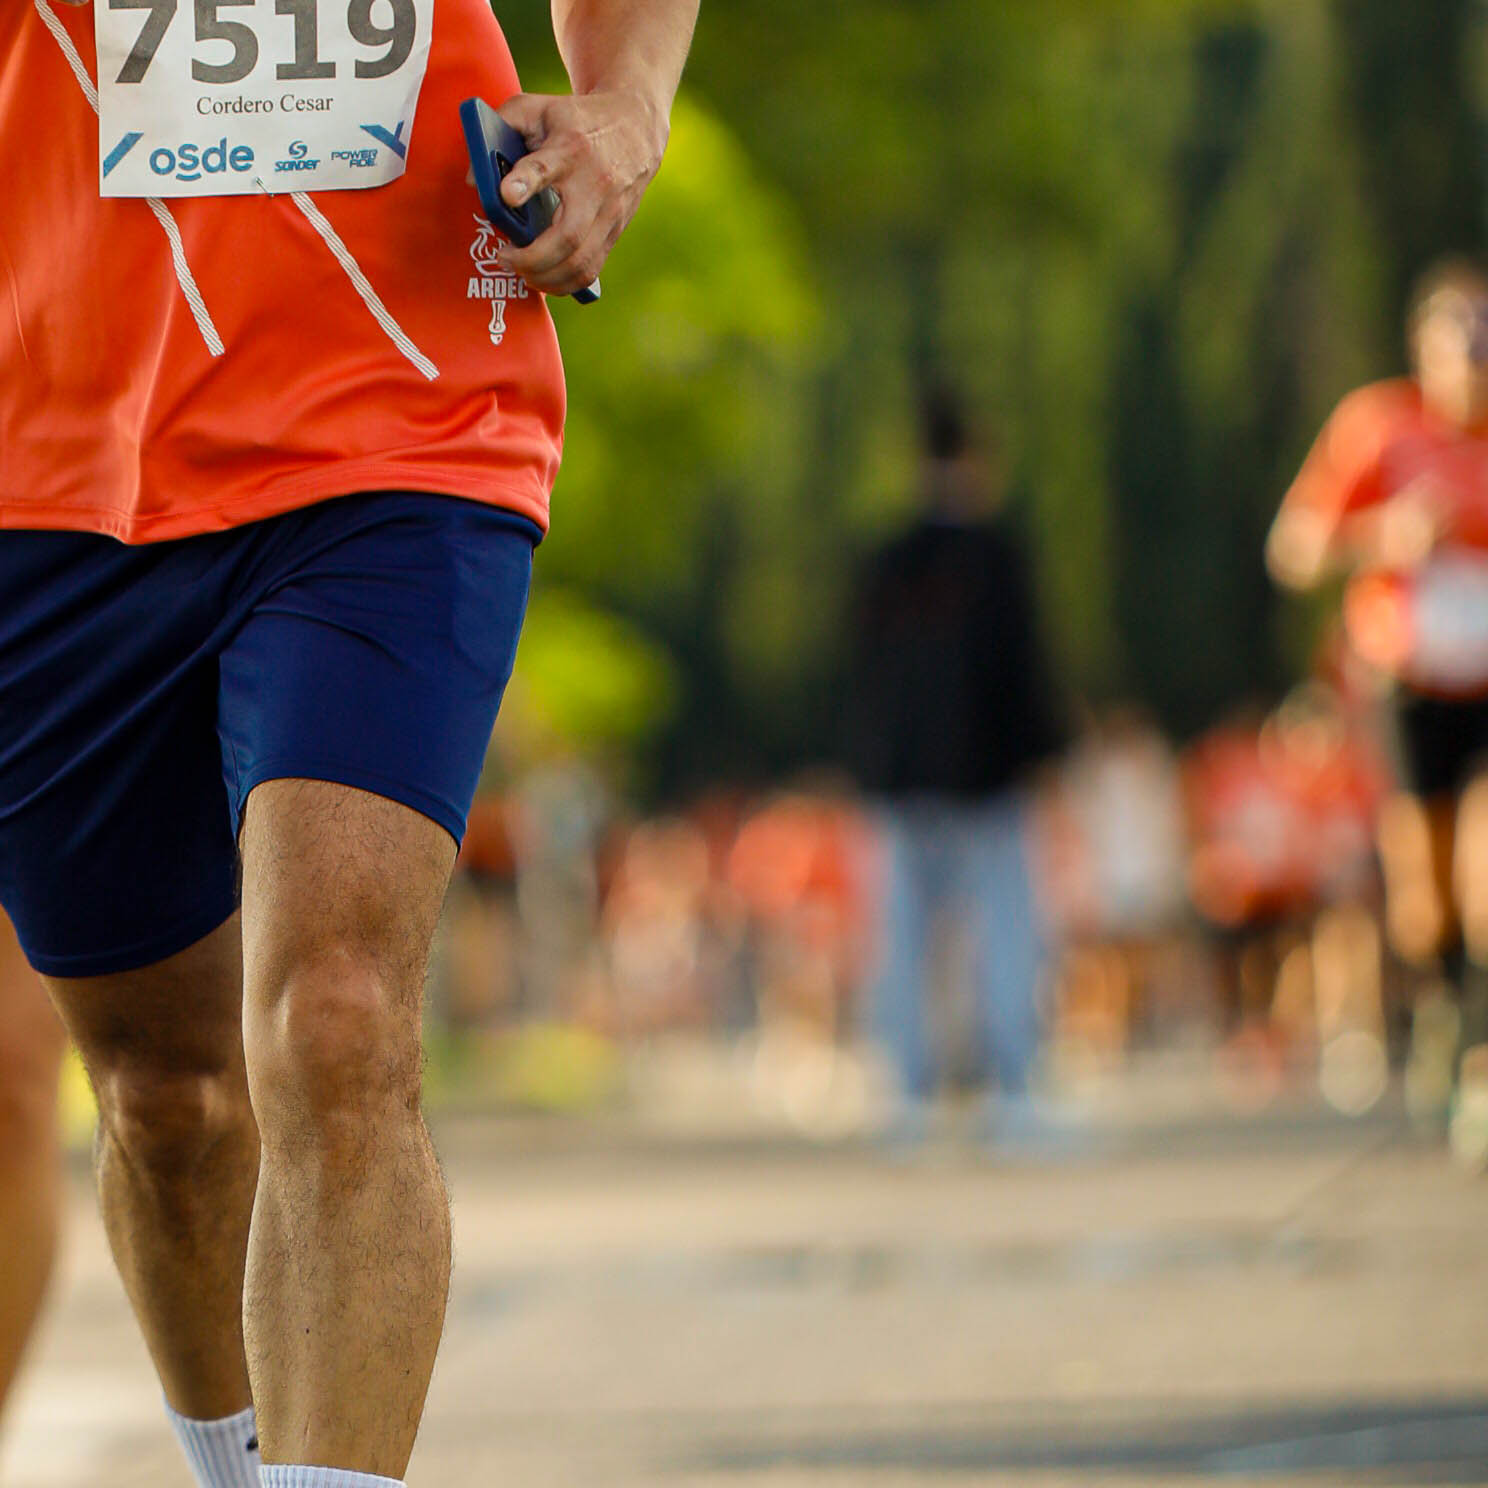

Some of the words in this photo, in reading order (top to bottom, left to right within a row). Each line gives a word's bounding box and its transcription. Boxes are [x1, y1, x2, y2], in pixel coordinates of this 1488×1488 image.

[196, 96, 274, 115] Cordero
[280, 94, 334, 112] Cesar
[149, 137, 255, 176] osde
[467, 277, 529, 299] ARDEC
